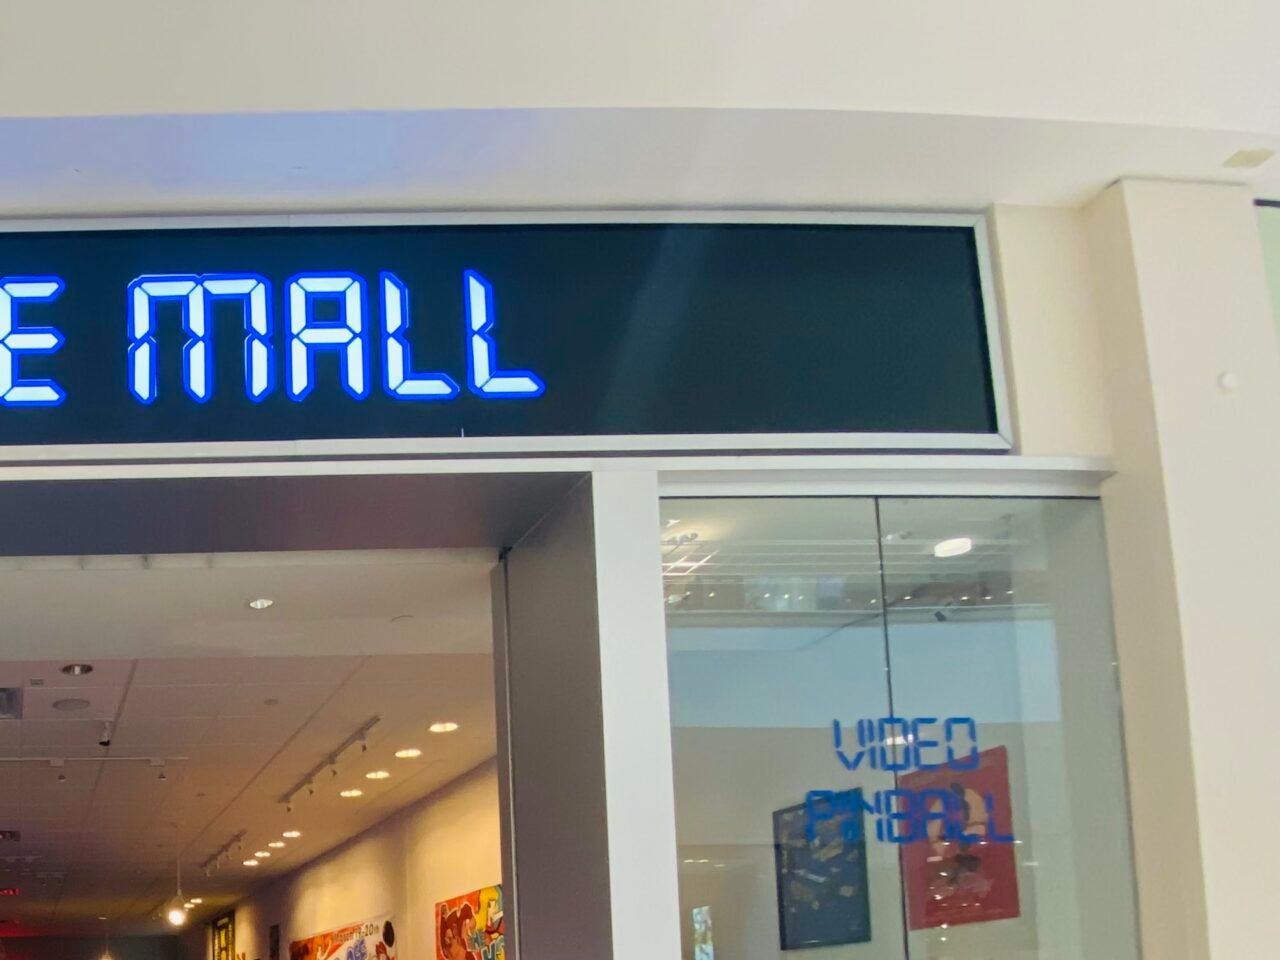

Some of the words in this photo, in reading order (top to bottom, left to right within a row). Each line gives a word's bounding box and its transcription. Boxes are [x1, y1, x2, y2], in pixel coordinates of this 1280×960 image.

[126, 270, 544, 403] MALL
[833, 716, 980, 771] VIDEO
[805, 790, 1018, 843] PINBALL
